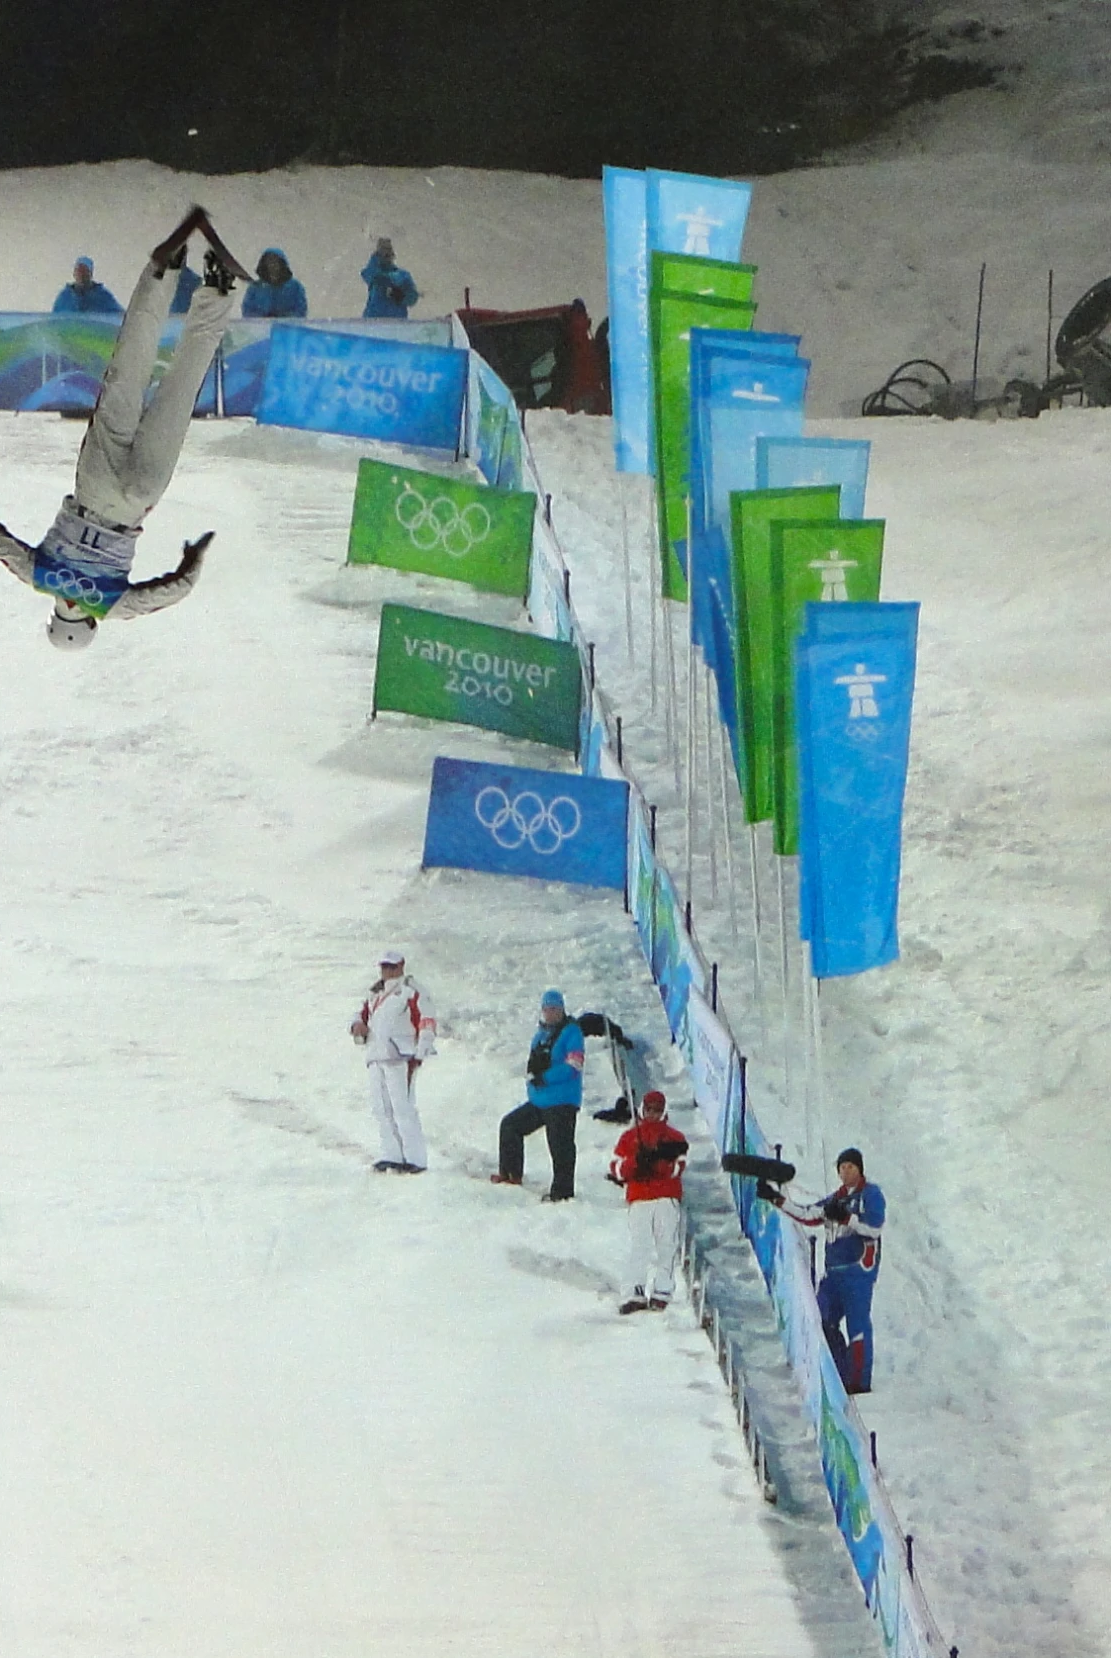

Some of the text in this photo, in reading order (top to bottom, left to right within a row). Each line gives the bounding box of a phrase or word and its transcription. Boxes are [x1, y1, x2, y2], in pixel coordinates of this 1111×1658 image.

[292, 354, 443, 393] vancouver
[404, 634, 558, 689] vancouver
[445, 669, 514, 706] 2010
